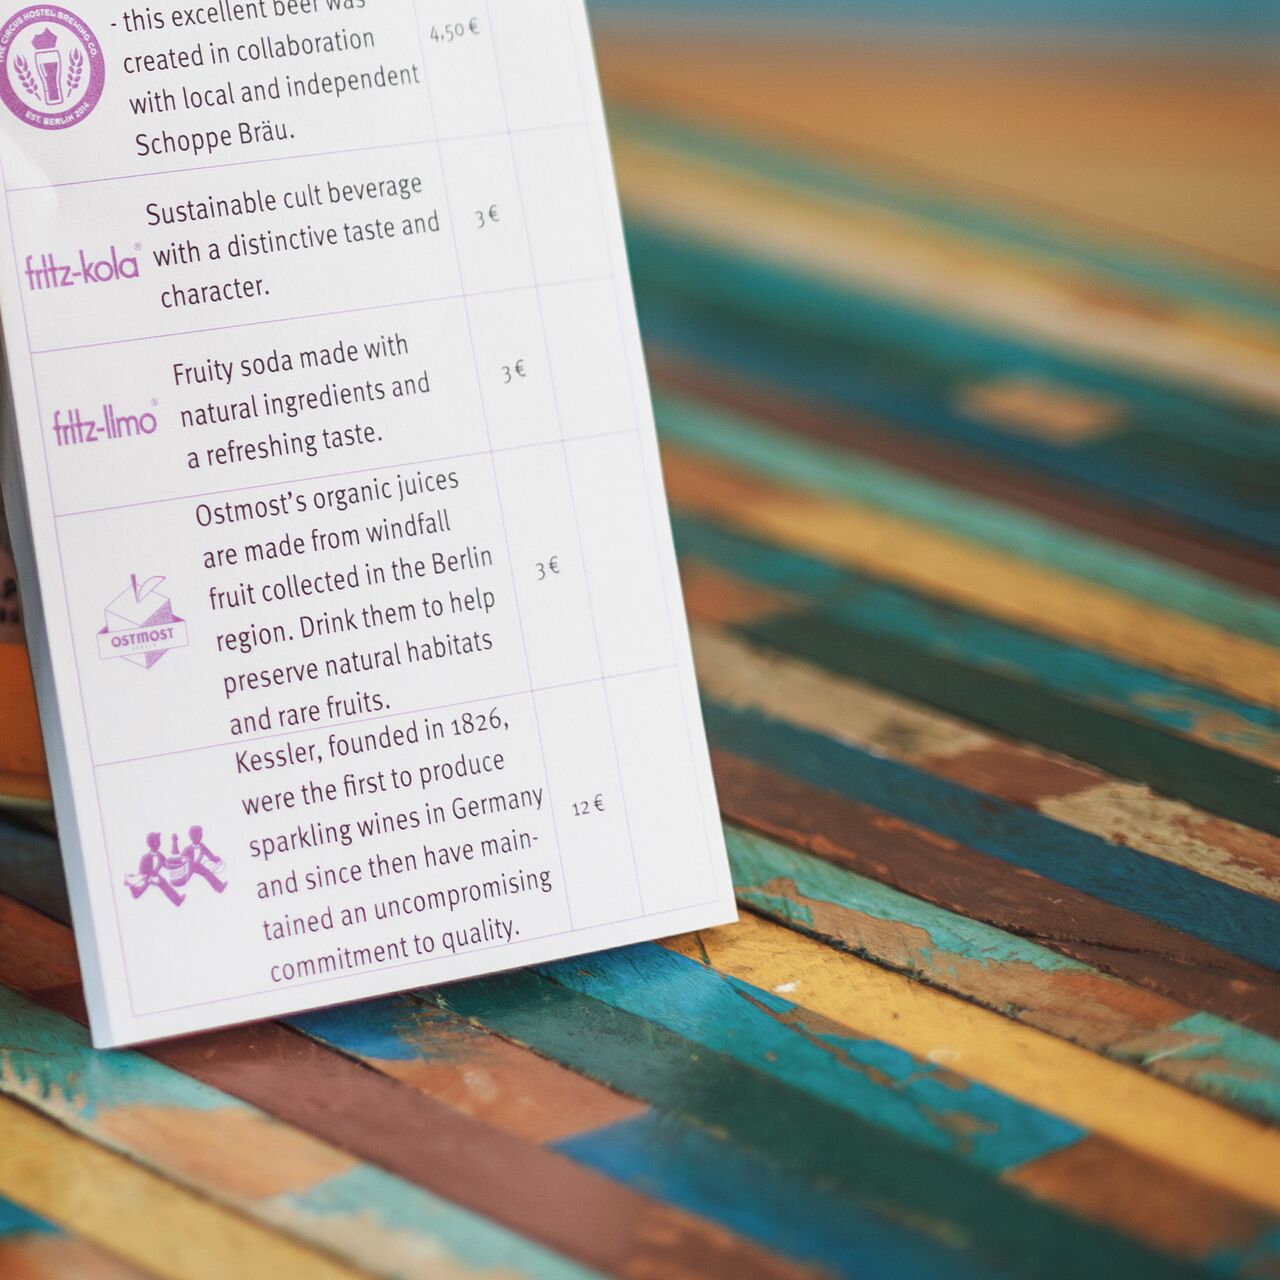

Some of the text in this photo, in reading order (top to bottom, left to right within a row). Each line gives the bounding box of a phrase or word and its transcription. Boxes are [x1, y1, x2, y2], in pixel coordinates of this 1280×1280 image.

[1, 16, 24, 44] CIRCUS
[23, 9, 56, 21] HOSTEL
[57, 11, 90, 42] BREWING
[123, 8, 164, 32] this
[124, 29, 374, 73] created in collaboration
[43, 102, 90, 125] BERLIN 2014
[129, 64, 419, 114] with local and independent
[136, 120, 294, 156] Schoppe Bräu.
[146, 177, 421, 226] Sustainable cult beverage
[153, 210, 439, 267] with a distinctive taste and
[25, 246, 139, 290] fritz-kola
[161, 278, 269, 308] character.
[173, 333, 408, 386] Fruity soda made with
[181, 370, 430, 427] natural ingredients and
[53, 404, 157, 446] fritz-limo
[187, 424, 382, 469] a refreshing taste.
[314, 478, 392, 511] organic
[397, 471, 458, 502] juices
[203, 509, 450, 568] are made from windfall
[209, 546, 492, 610] fruit collected in the Berlin
[111, 628, 173, 648] OSTMOST
[217, 587, 495, 653] region. Drink them to help
[224, 632, 492, 699] preserve natural habitats
[230, 691, 390, 735] and rare fruits.
[236, 707, 508, 774] Kessler, founded in 1826,
[242, 753, 504, 815] were the first to produce
[572, 801, 590, 816] 12
[249, 788, 542, 861] sparkling wines in Germany
[257, 829, 538, 899] and since then have main-
[263, 870, 552, 940] tained an uncompromising
[271, 918, 519, 982] commitment to quality.
